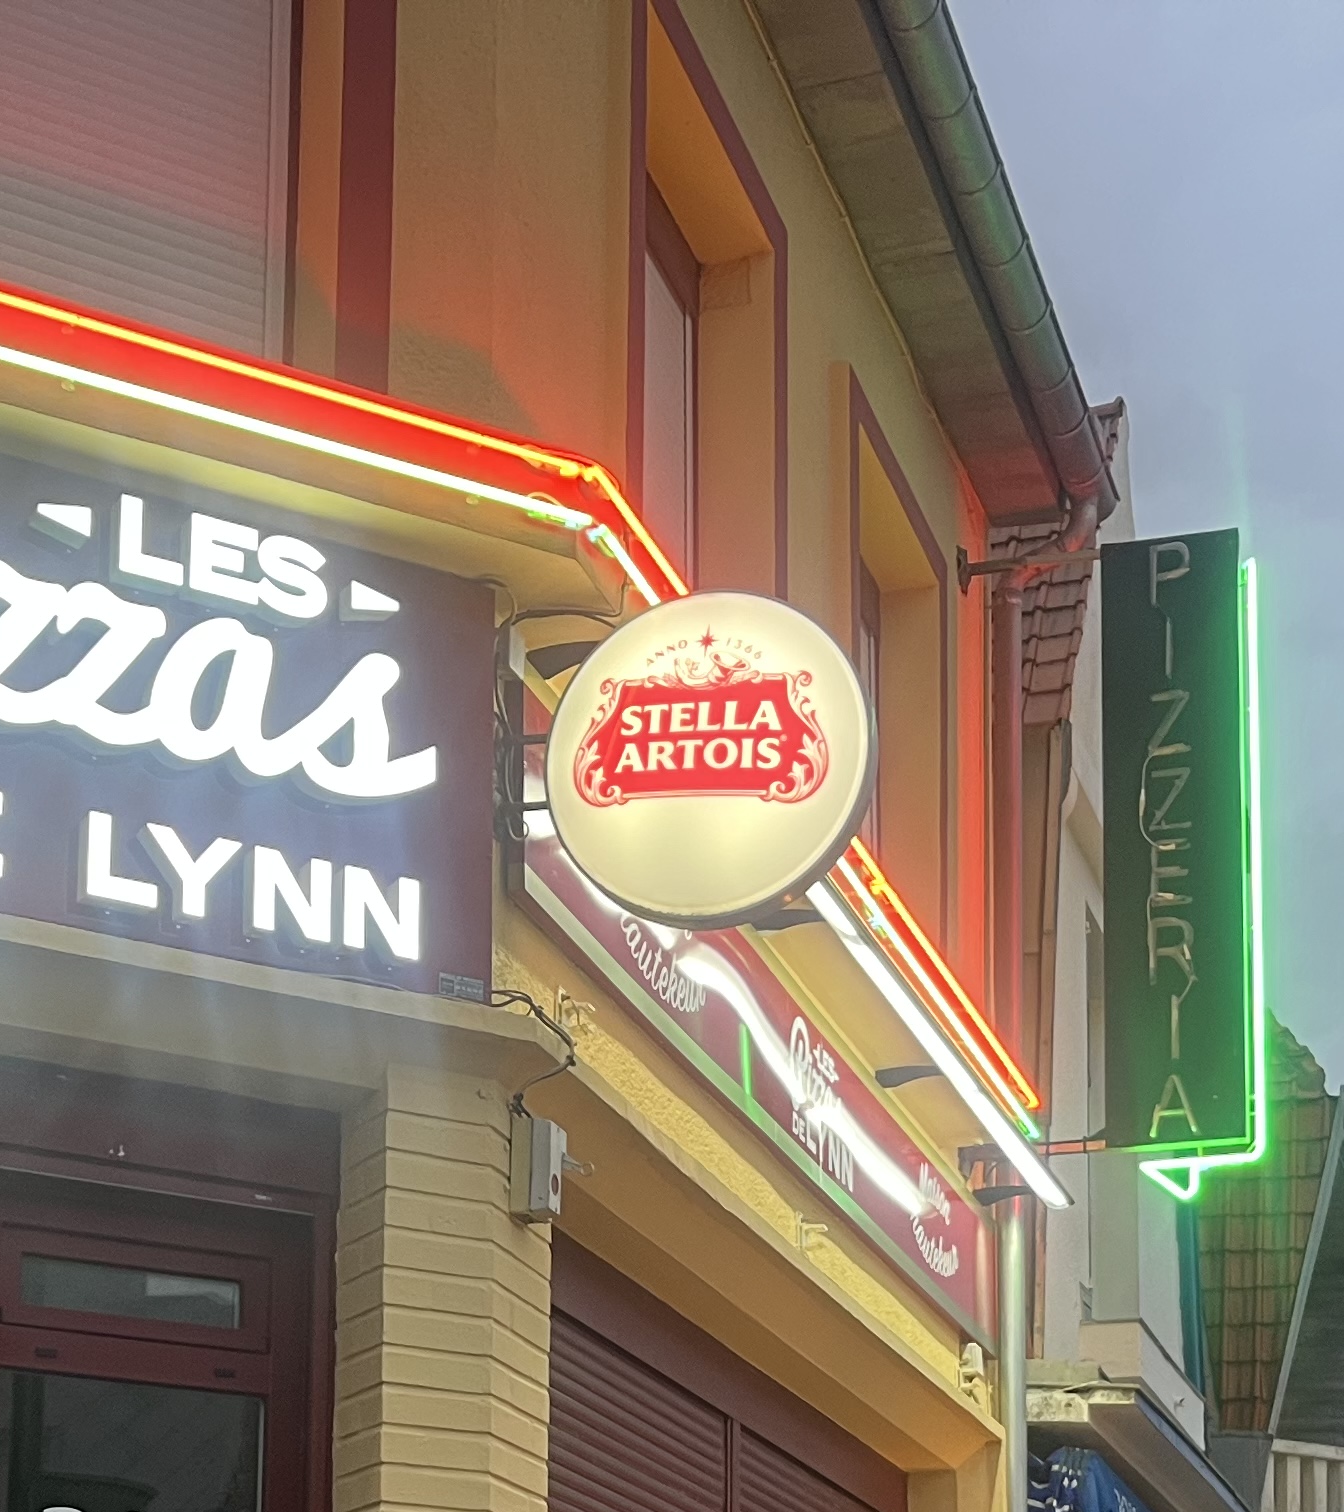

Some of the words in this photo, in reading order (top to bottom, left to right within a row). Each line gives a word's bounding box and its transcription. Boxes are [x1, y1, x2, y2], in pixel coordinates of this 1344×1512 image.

[117, 492, 328, 620] LES
[646, 638, 689, 668] ANNO
[725, 636, 763, 660] 1366
[614, 737, 782, 774] ARTOIS
[620, 700, 783, 737] STELLA
[1146, 540, 1200, 1139] PIZZERIA
[86, 809, 422, 962] LYNN
